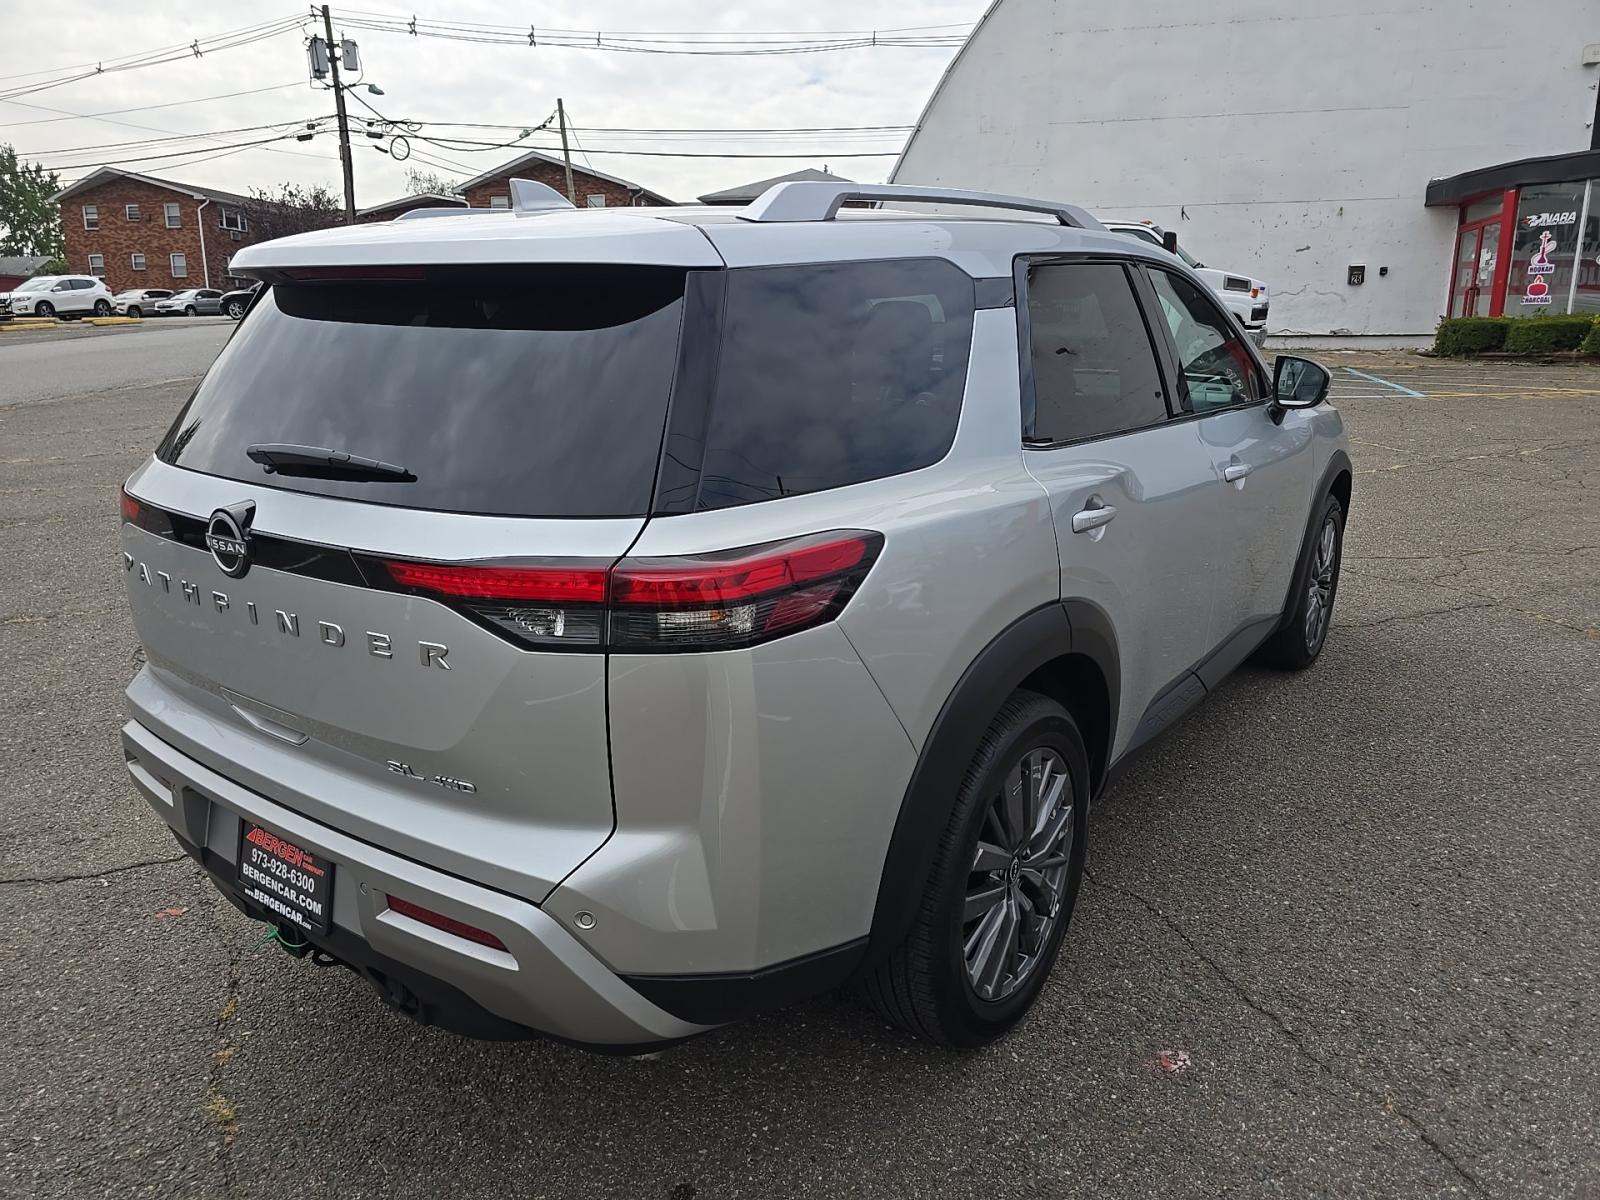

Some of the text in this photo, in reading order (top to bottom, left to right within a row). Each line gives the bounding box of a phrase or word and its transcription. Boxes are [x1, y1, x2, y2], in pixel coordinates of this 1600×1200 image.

[124, 551, 451, 670] PATHFINDER
[387, 760, 425, 779] SL
[255, 828, 303, 867] BERGEN
[242, 862, 322, 915] BERGENCAR.COM
[251, 848, 315, 893] 973-928-6300
